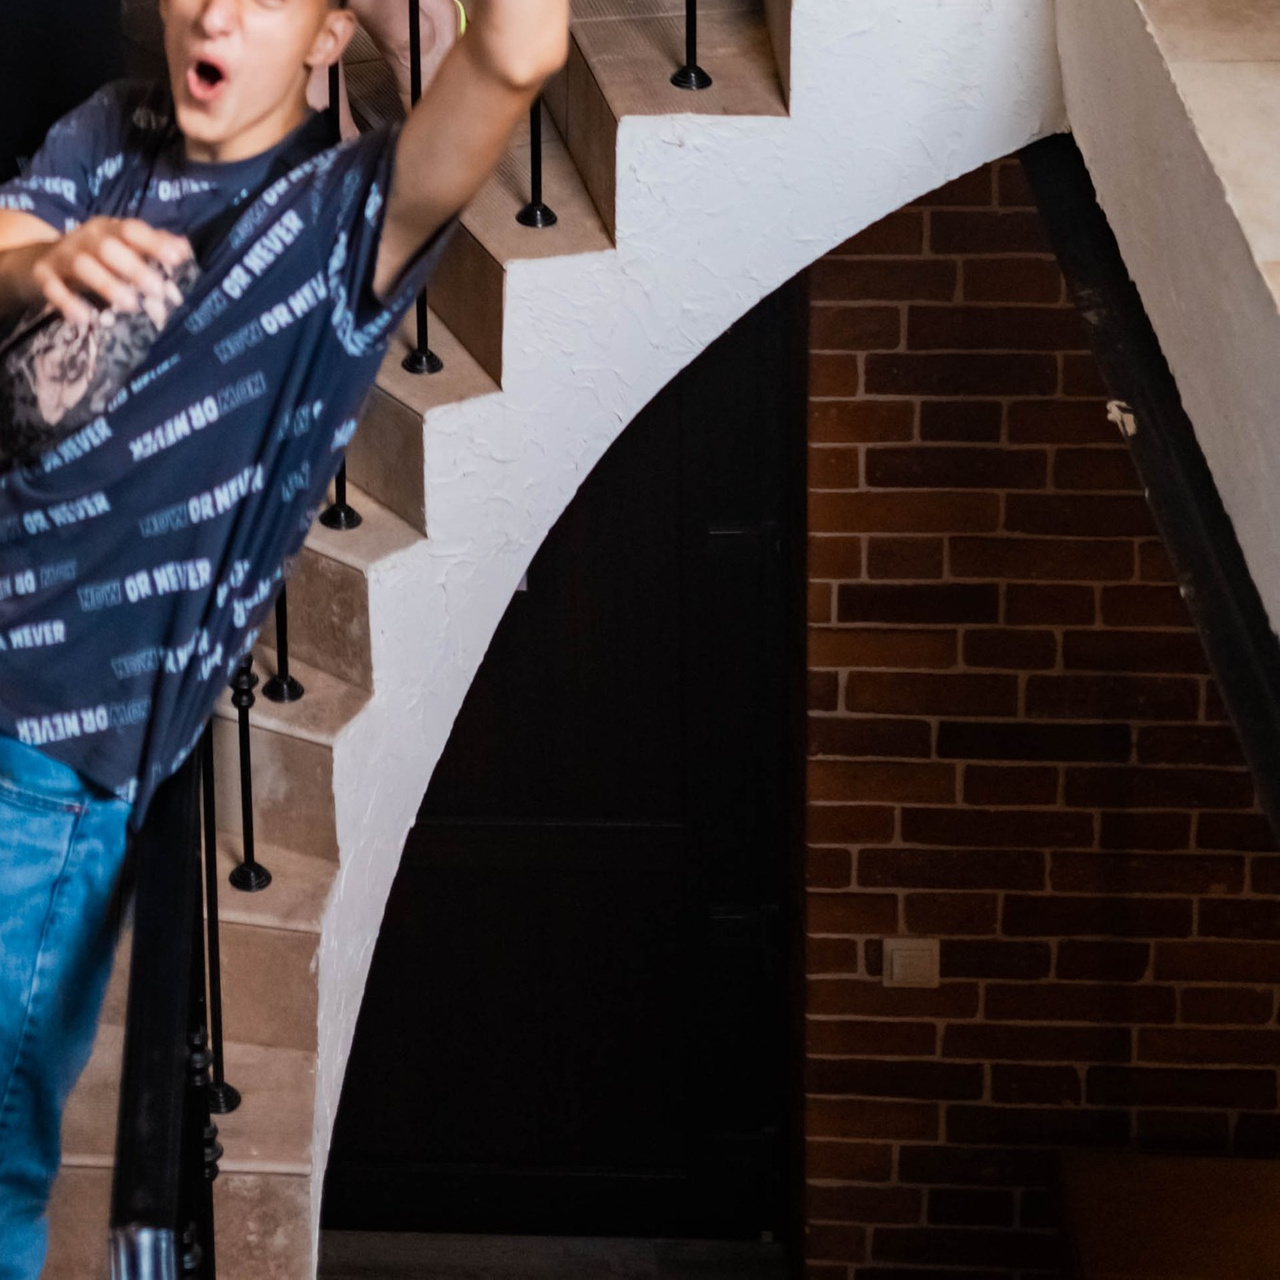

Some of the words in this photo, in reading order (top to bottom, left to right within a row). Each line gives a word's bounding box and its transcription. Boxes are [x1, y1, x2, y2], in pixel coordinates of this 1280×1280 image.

[222, 264, 252, 300] OR
[242, 209, 305, 277] NEVER
[260, 302, 294, 335] OR
[189, 394, 219, 430] OR
[128, 410, 191, 463] NEVER
[188, 491, 215, 525] OR
[124, 569, 152, 603] OR
[152, 557, 211, 596] NEVER
[9, 619, 66, 649] NEVER
[17, 711, 82, 746] NEVER
[81, 704, 109, 734] OR
